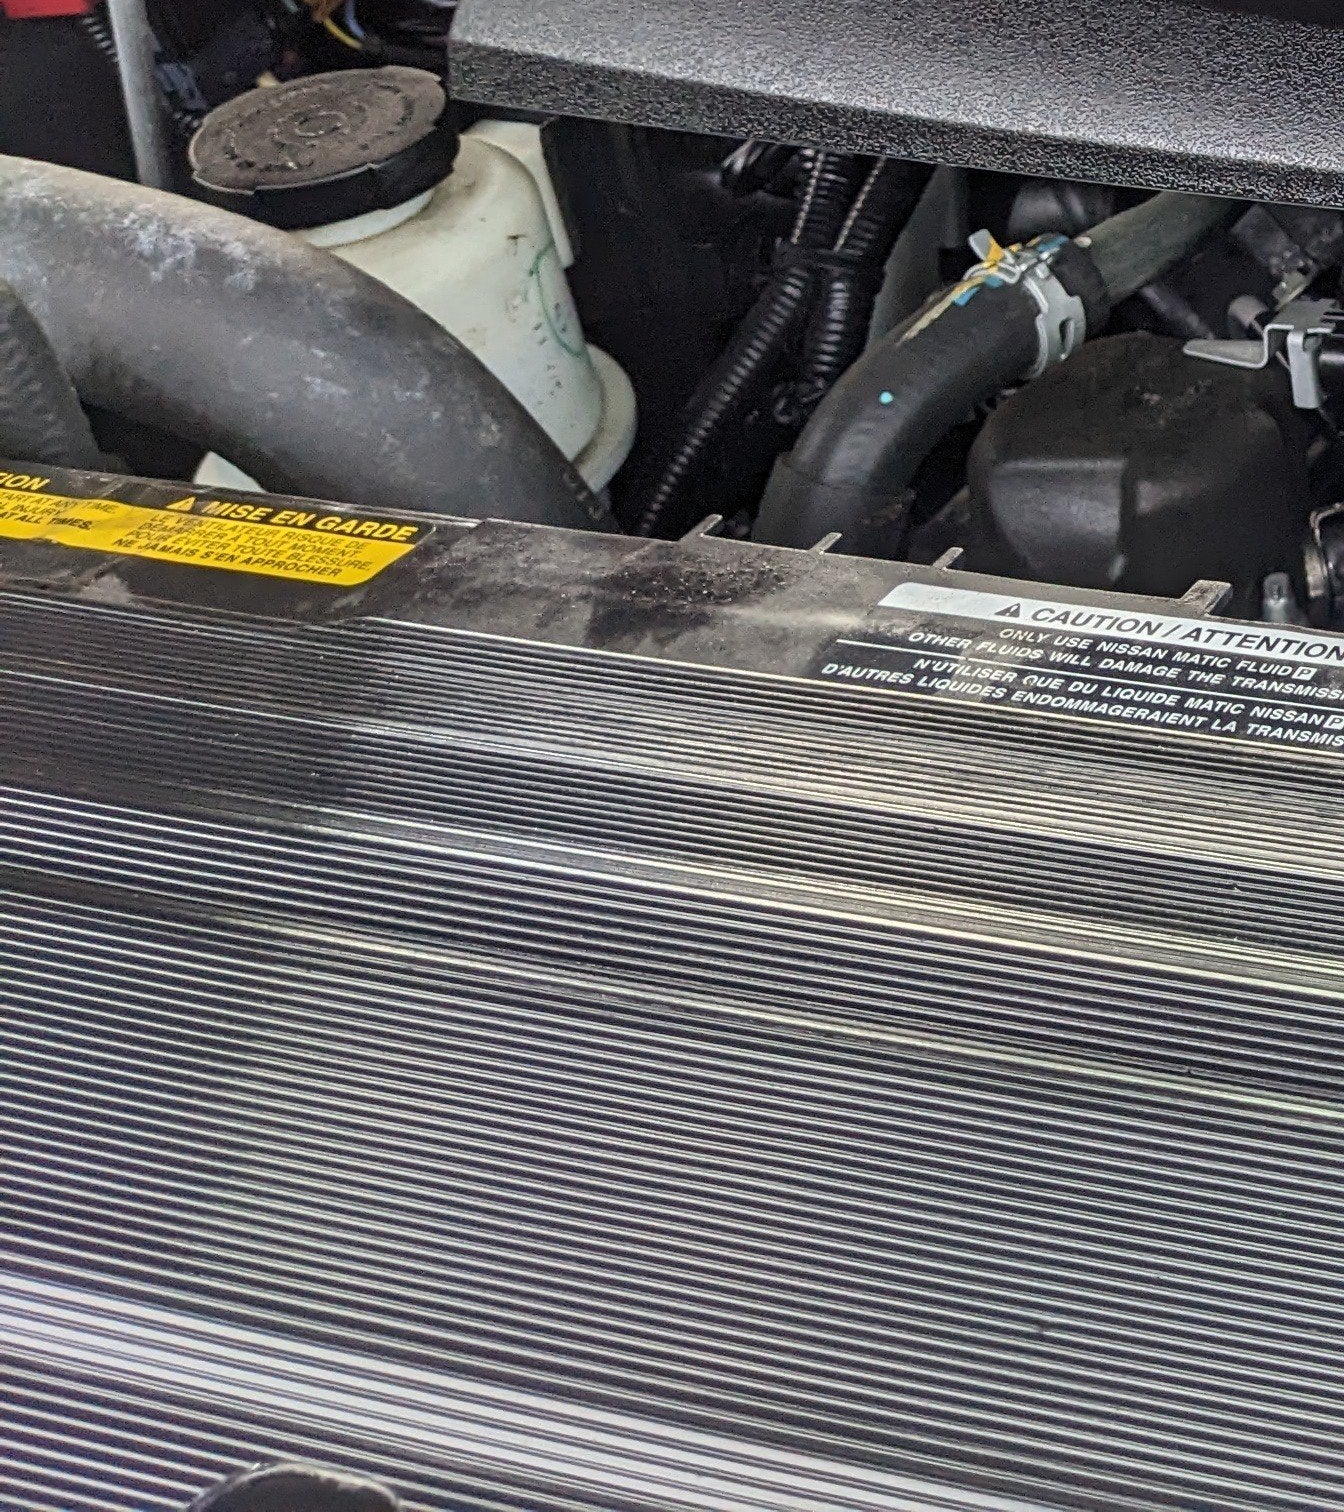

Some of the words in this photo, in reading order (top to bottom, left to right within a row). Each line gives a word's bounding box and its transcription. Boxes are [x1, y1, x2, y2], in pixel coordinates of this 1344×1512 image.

[176, 516, 280, 536] VENTILATEUR
[281, 530, 343, 546] RISQUE
[344, 540, 371, 550] DE
[201, 500, 274, 521] MISE
[270, 510, 316, 526] EN
[315, 516, 419, 541] GARDE
[113, 538, 140, 548] NE
[138, 542, 200, 557] JAMAIS
[233, 544, 288, 558] TOUTE
[244, 535, 287, 549] TOUT
[1031, 607, 1164, 637] CAUTION
[909, 632, 973, 650] OTHER
[976, 641, 1044, 660] FLUIDS
[1049, 651, 1092, 667] WILL
[1098, 659, 1182, 679] DAMAGE
[1188, 670, 1227, 685] THE
[1000, 628, 1051, 644] ONLY
[1053, 635, 1094, 650] USE
[1096, 641, 1169, 659] NISSAN
[1171, 651, 1232, 668] MATIC
[1235, 660, 1293, 676] FLUID
[821, 663, 915, 685] D'AUTRES
[917, 675, 1008, 699] LIQUIDES
[1011, 690, 1209, 727] ENDOMMAGERAIENT
[1209, 717, 1238, 733] LA
[913, 658, 1019, 683] N'UTILISER
[1022, 674, 1067, 690] QUE
[1068, 680, 1099, 694] DU
[1100, 686, 1182, 707] LIQUIDE
[1184, 697, 1246, 715] MATIC
[1250, 706, 1326, 727] NISSAN
